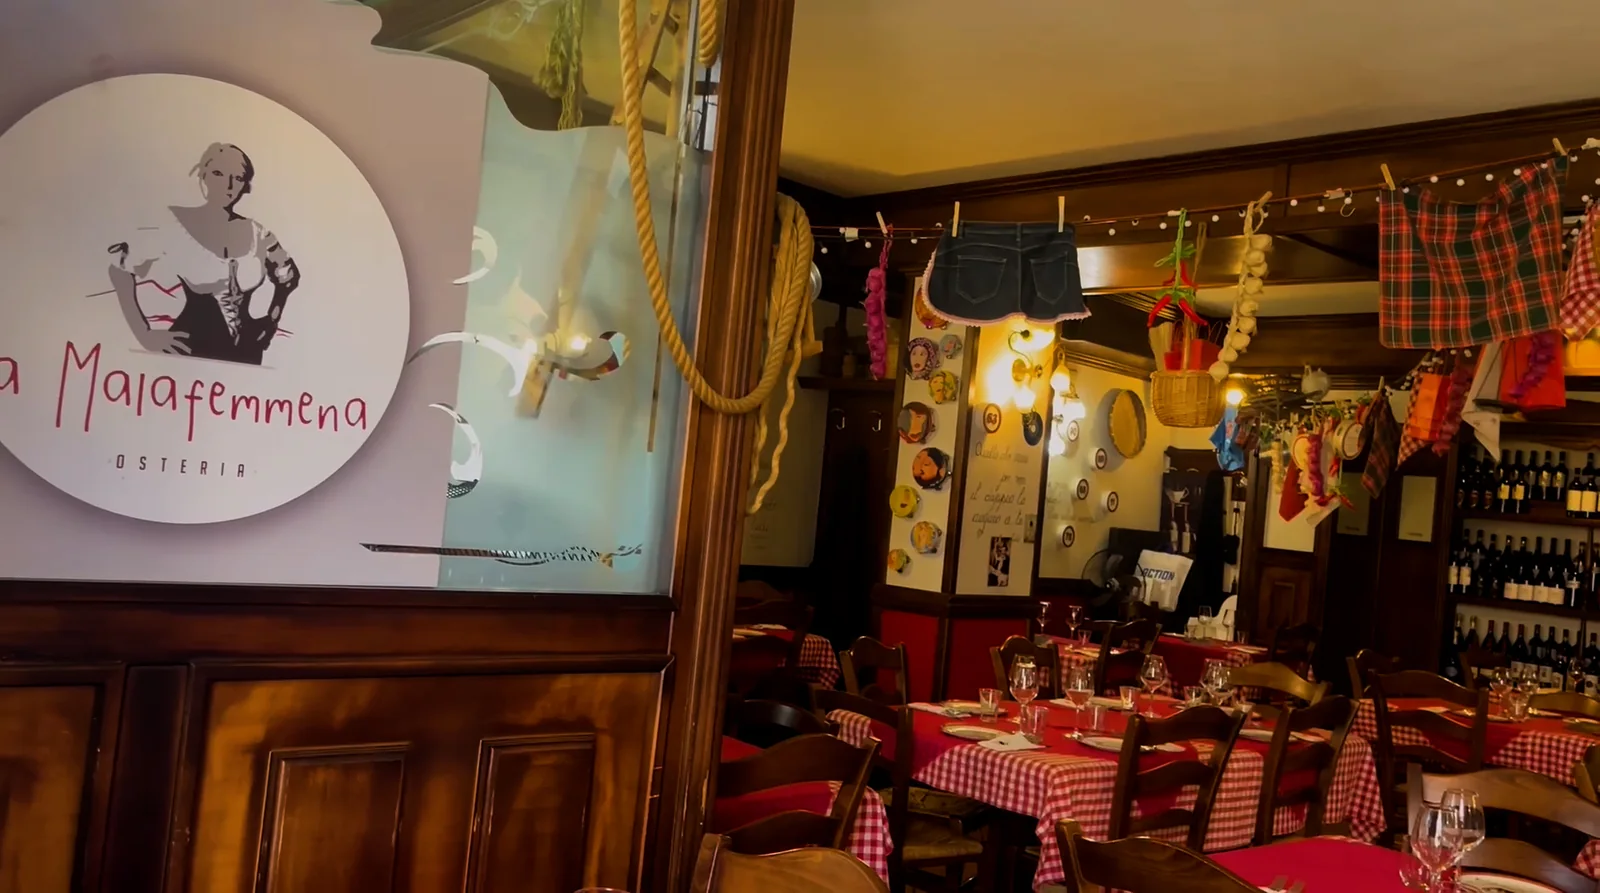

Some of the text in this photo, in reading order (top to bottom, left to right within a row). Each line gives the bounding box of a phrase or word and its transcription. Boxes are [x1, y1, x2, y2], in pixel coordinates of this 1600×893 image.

[55, 341, 367, 442] Malafemmena
[116, 454, 245, 477] OSTERIA
[1143, 568, 1175, 581] ACTION
